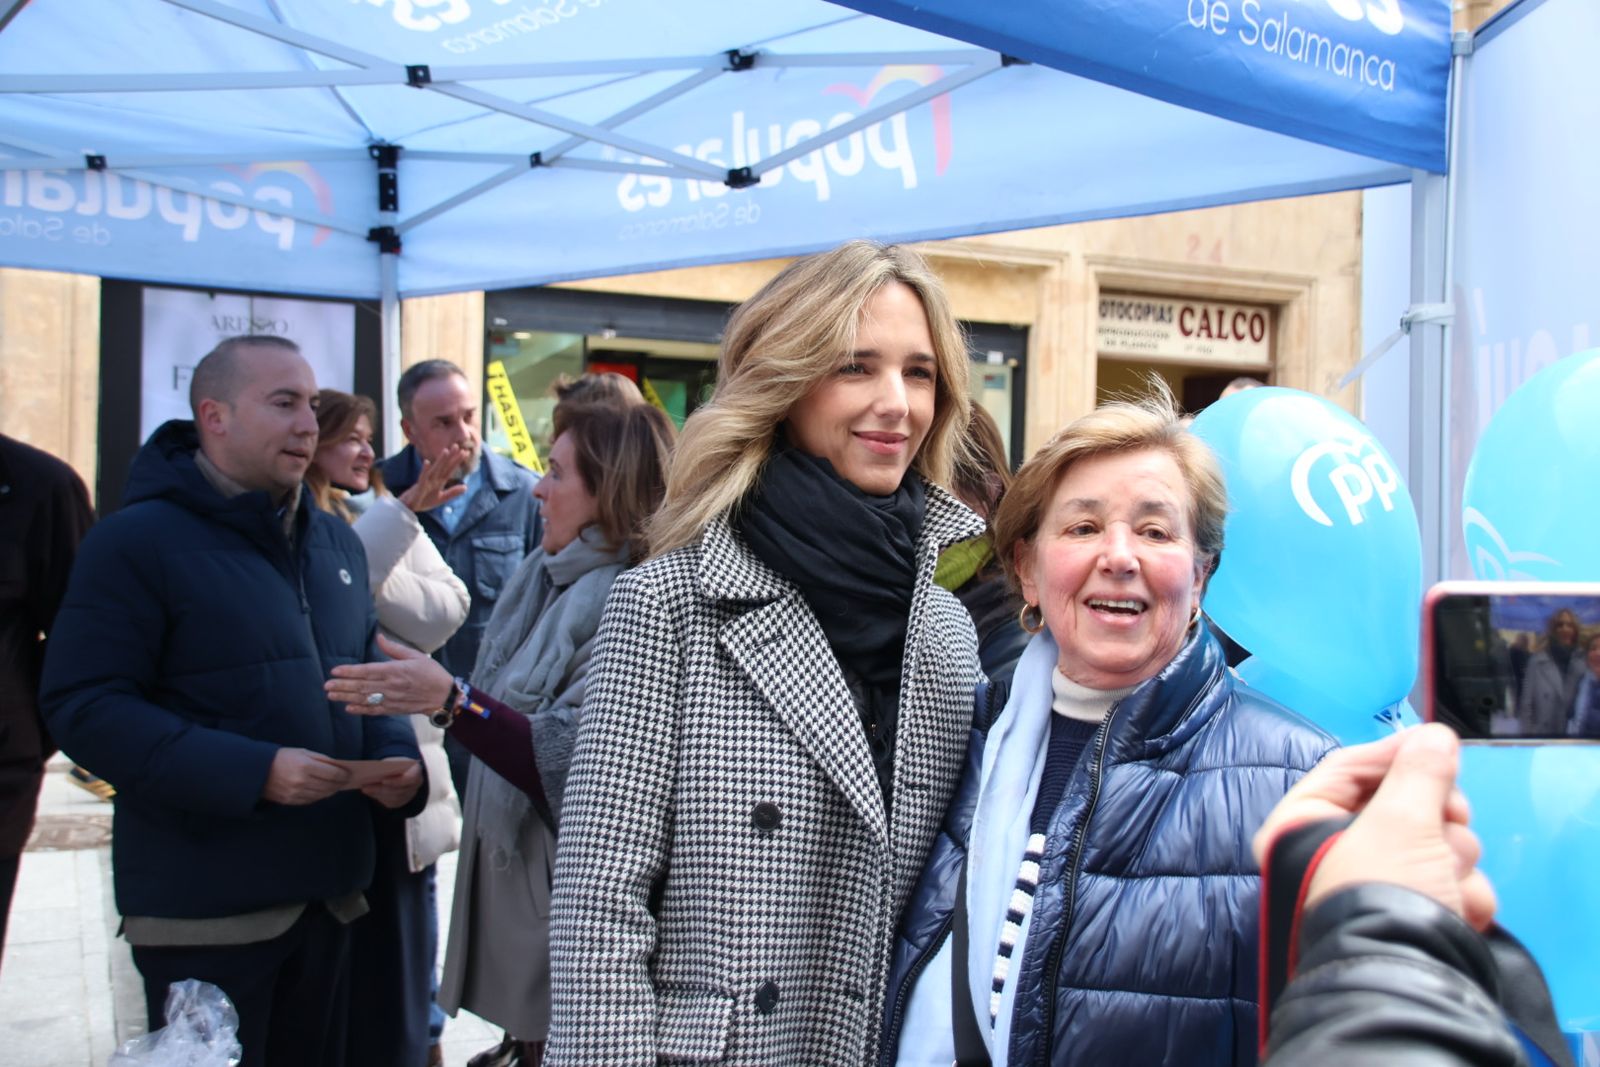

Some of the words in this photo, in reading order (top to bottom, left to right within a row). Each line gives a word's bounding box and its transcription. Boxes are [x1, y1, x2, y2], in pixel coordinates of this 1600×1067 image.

[1187, 0, 1230, 35] de
[1238, 0, 1397, 92] Salamanca
[1099, 299, 1174, 324] OTOCOPIAS
[1179, 304, 1265, 343] CALCO
